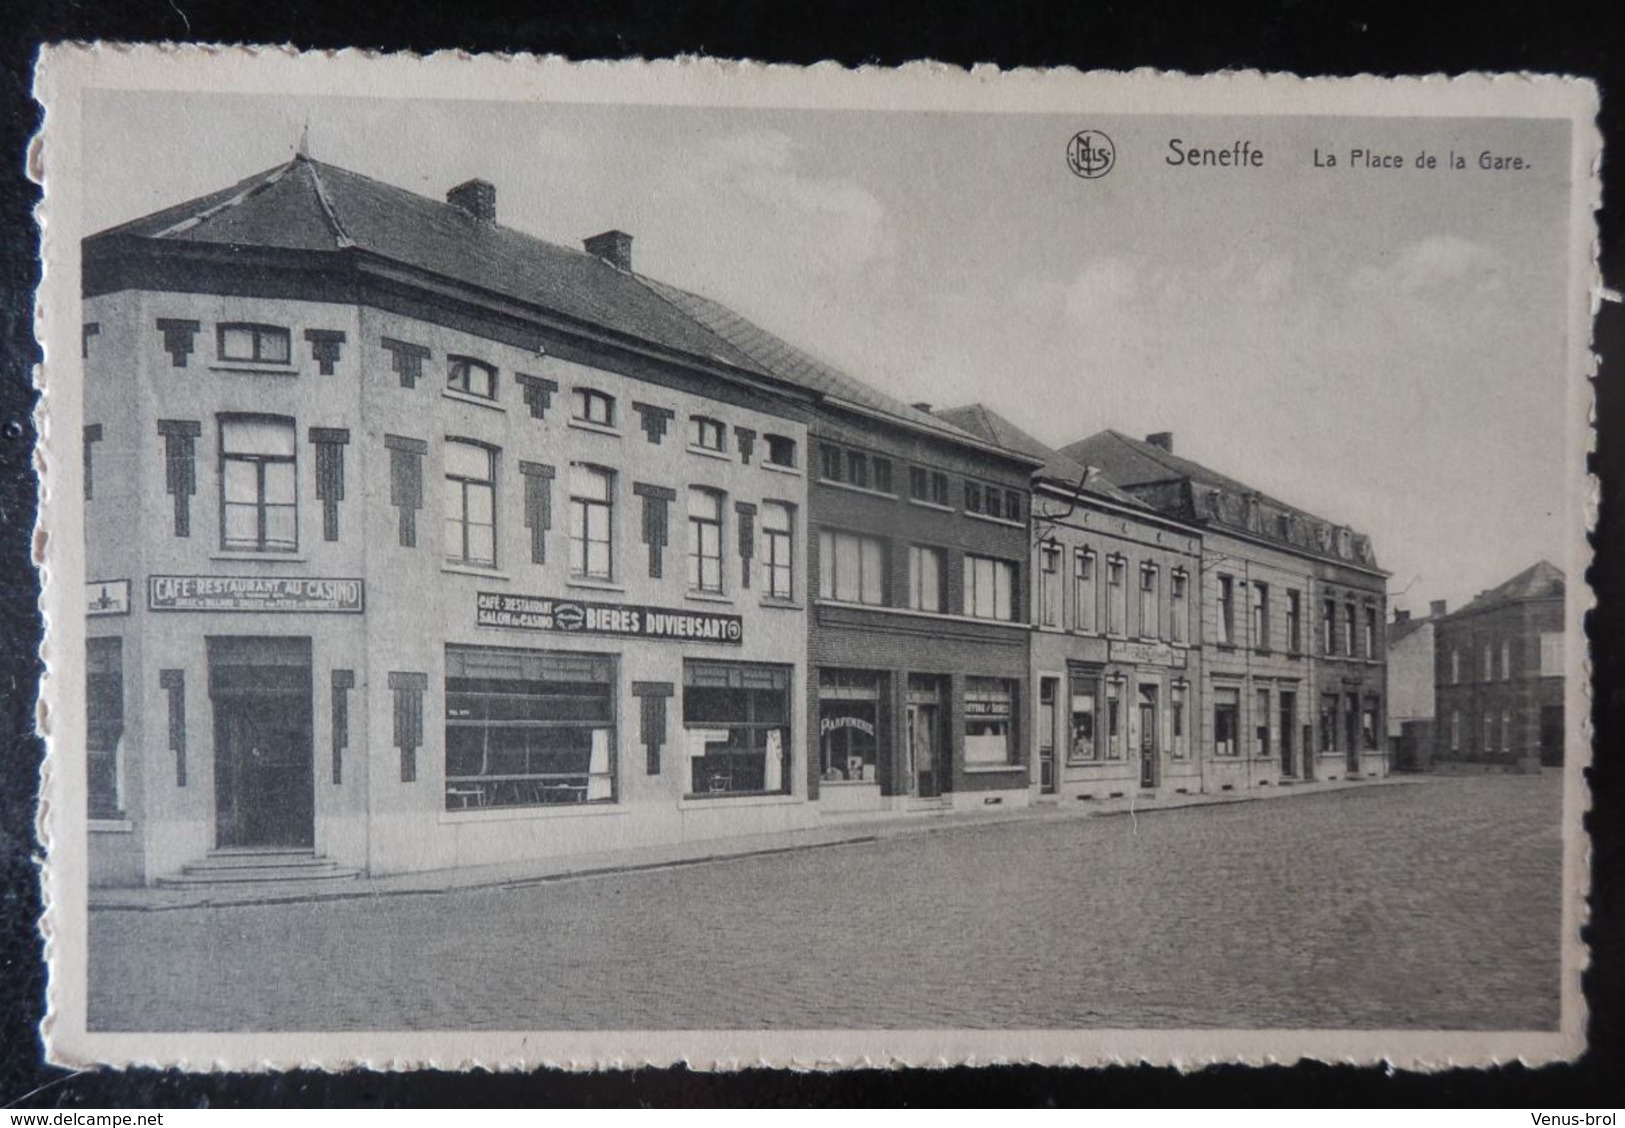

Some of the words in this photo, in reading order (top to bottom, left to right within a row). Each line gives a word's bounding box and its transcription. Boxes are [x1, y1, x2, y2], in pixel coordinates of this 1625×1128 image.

[1165, 138, 1264, 167] Seneffe
[1313, 149, 1337, 168] La
[1350, 150, 1403, 169] Place
[1415, 151, 1437, 169] de
[1450, 151, 1466, 170] la
[1479, 151, 1531, 170] Gare.
[285, 581, 302, 596] AU
[307, 582, 357, 604] CASINO
[586, 608, 640, 632] BIERES
[646, 613, 728, 639] DUVIEUSART
